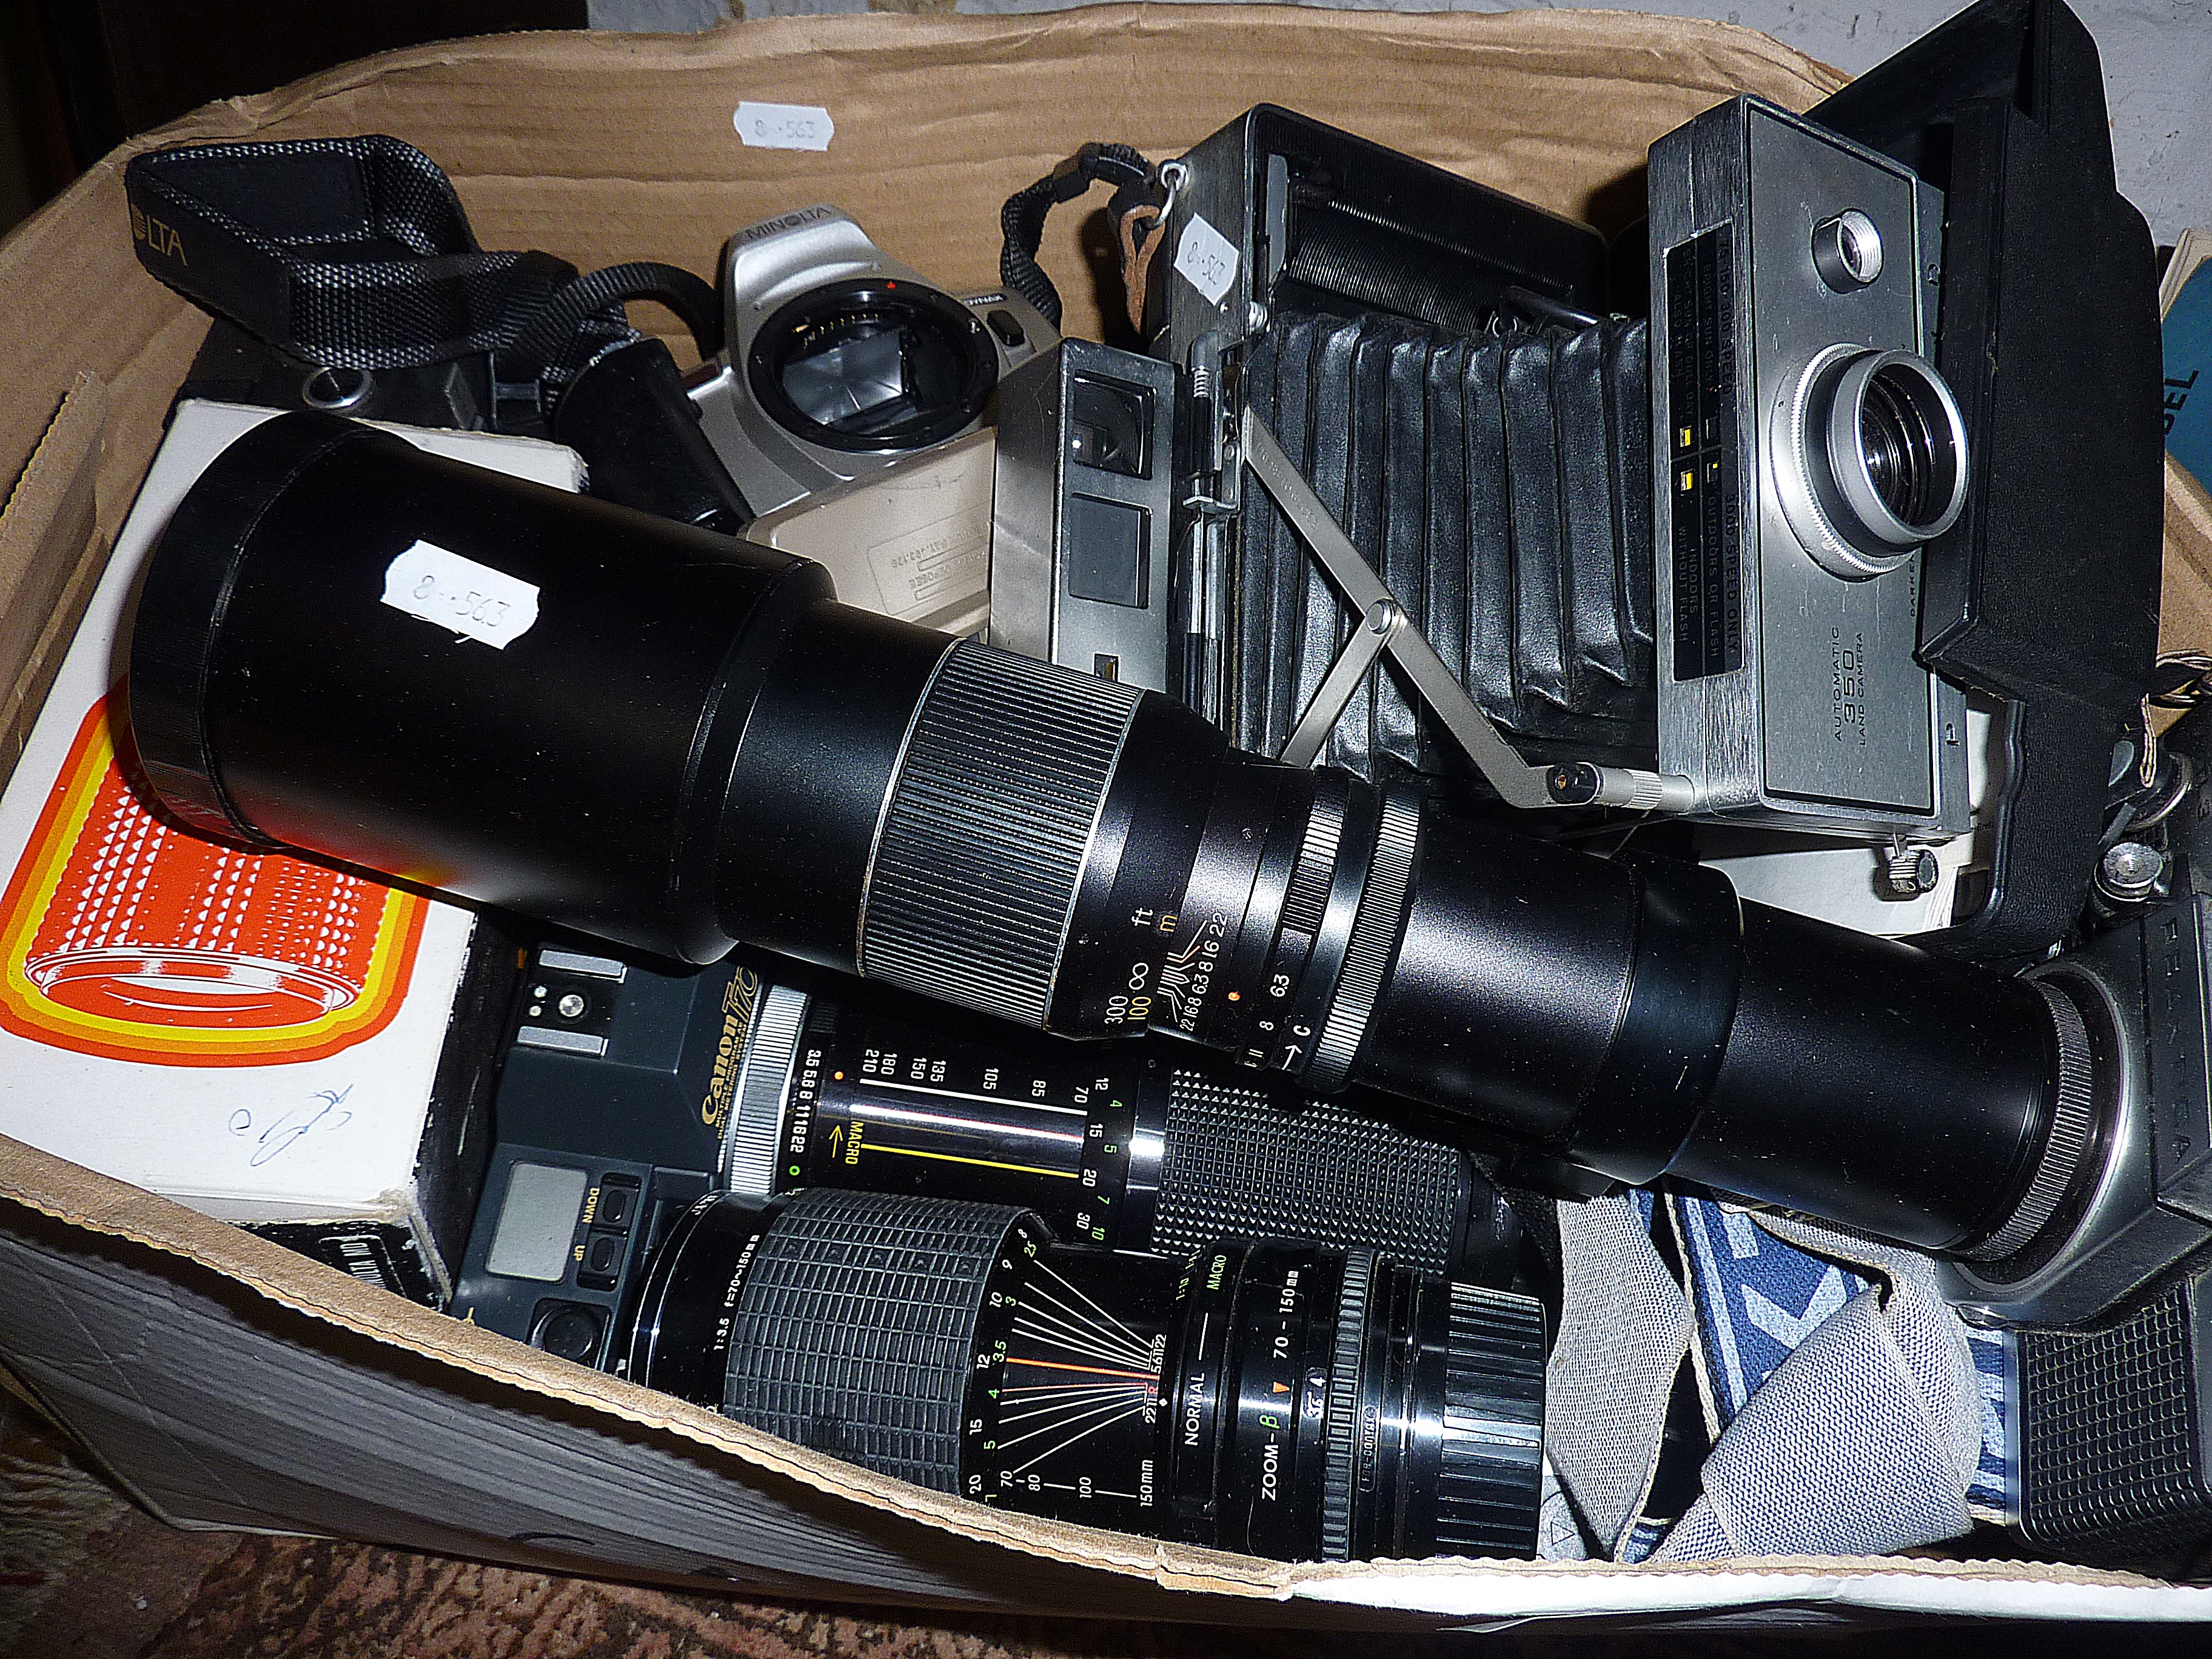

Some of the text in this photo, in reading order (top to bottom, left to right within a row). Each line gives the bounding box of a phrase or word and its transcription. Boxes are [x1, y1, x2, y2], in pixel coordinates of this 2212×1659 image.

[745, 207, 831, 239] MINOLTA
[1682, 247, 1693, 295] BRGHT
[1703, 264, 1714, 383] BRIGHT SUN ONLY
[1721, 338, 1733, 395] SPEED
[1678, 526, 1689, 642] WITHOUT FLASH
[1688, 548, 1698, 614] INDOORS
[1707, 496, 1719, 657] OUTDOORS OR FLASH
[1725, 494, 1738, 652] 3000 SPEED ONLY
[1856, 632, 1865, 698] CAMERA
[1832, 626, 1842, 742] AUTOMATIC
[1842, 649, 1855, 724] 350
[1131, 907, 1153, 927] ft
[1159, 914, 1178, 933] m
[1208, 911, 1228, 937] 22
[1202, 940, 1219, 958] 16
[1198, 961, 1213, 973] 8
[1104, 995, 1128, 1024] 300
[1127, 996, 1151, 1020] 100
[1183, 1007, 1199, 1018] 16
[1187, 997, 1202, 1008] 8
[1179, 1018, 1196, 1031] 22
[1259, 1021, 1274, 1031] 8
[1293, 1025, 1311, 1036] C
[702, 1014, 739, 1125] Canon
[862, 1049, 879, 1073] 210
[881, 1053, 897, 1075] 180
[911, 1057, 927, 1079] 150
[930, 1060, 947, 1082] 135
[716, 1085, 728, 1128] MULTIPLE
[726, 1036, 740, 1082] PROGRAM
[717, 1024, 748, 1139] DUAL METERING SYSTEM
[983, 1068, 999, 1090] 105
[1031, 1080, 1047, 1097] 85
[799, 1090, 813, 1099] 8
[1074, 1086, 1089, 1104] 70
[790, 1136, 806, 1153] 22
[845, 1121, 864, 1165] MACRO
[1076, 1078, 1109, 1230] 12 15 20 30
[1104, 1144, 1117, 1153] 5
[581, 1187, 600, 1224] DOWN
[1098, 1195, 1110, 1205] 7
[1091, 1225, 1105, 1241] 10
[573, 1245, 586, 1262] UP
[1005, 1296, 1016, 1307] 3
[992, 1339, 1007, 1362] 3.5
[1155, 1334, 1167, 1349] 22
[1184, 1255, 1227, 1446] MACRO NORMAL
[969, 1228, 1028, 1494] 8 9 10 12 15 20
[988, 1389, 1000, 1399] 4
[1145, 1407, 1156, 1424] 22
[984, 1440, 996, 1450] 5
[1000, 1470, 1013, 1487] 70
[1028, 1474, 1041, 1492] 80
[1079, 1476, 1092, 1498] 100
